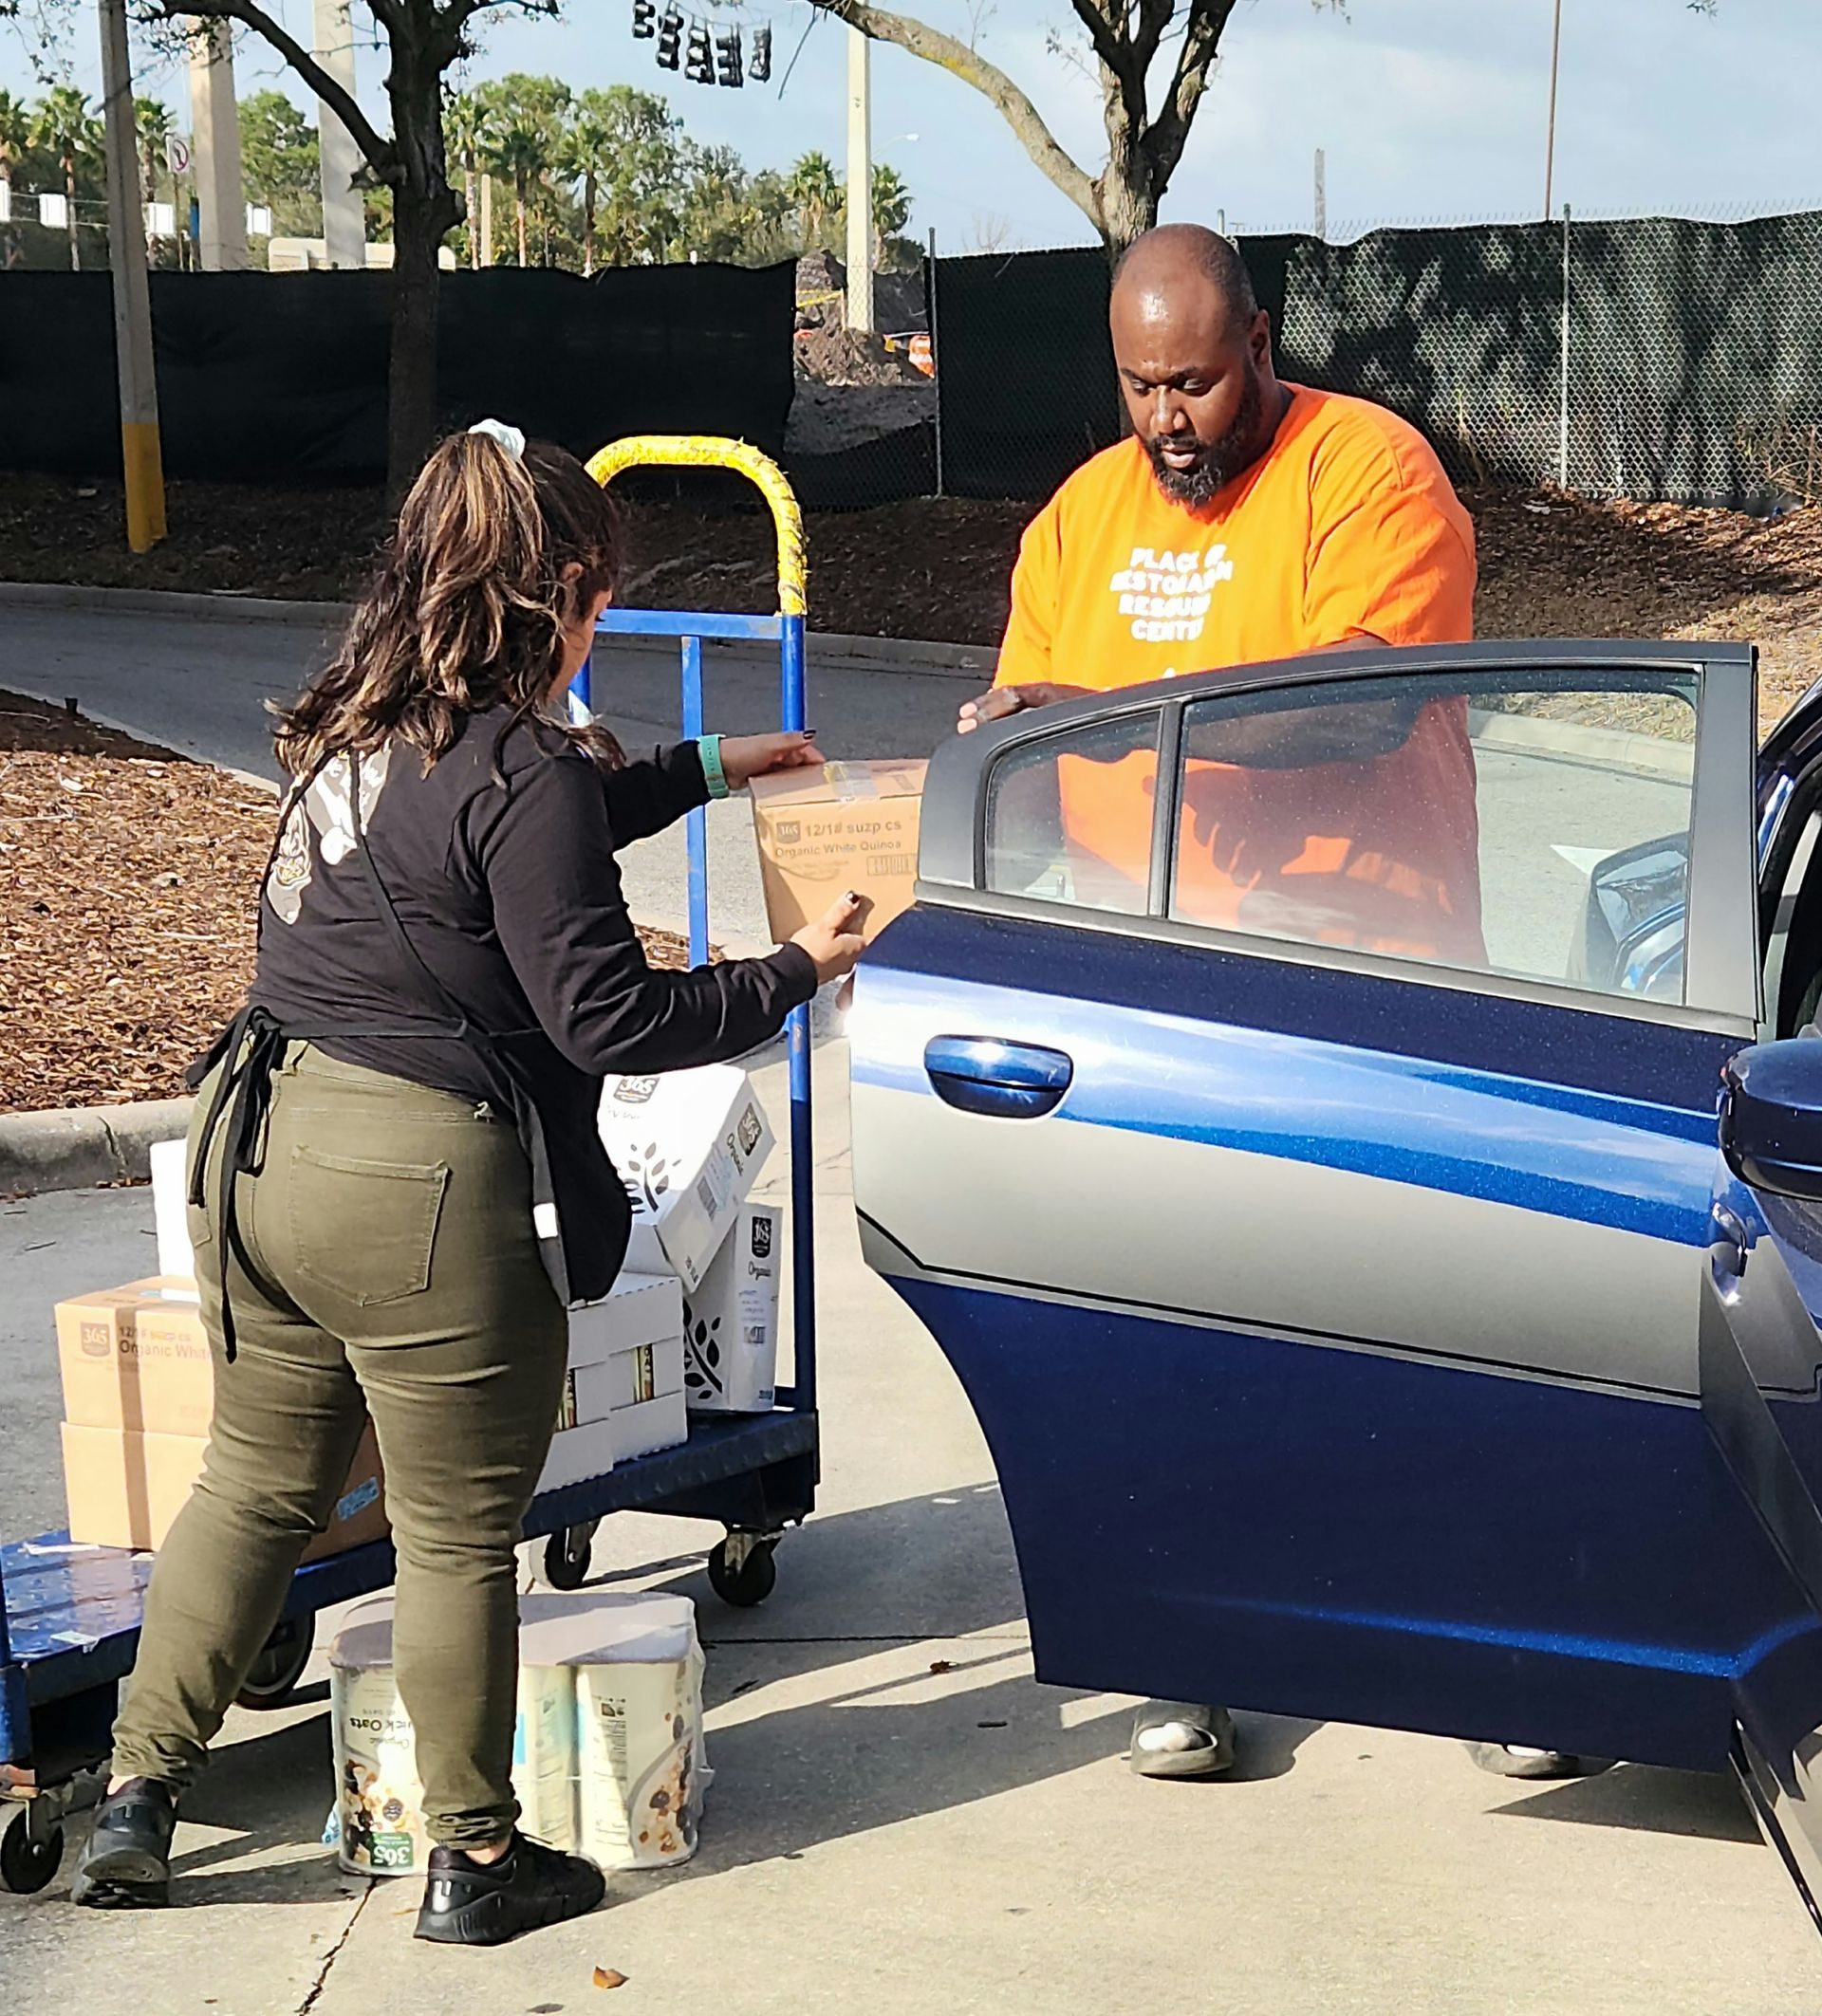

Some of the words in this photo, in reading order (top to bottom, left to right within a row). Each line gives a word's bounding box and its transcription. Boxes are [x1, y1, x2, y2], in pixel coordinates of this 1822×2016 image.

[884, 820, 902, 832] cs
[775, 842, 822, 859] Organic
[823, 842, 857, 854] White
[860, 841, 902, 852] Quinoa
[84, 1327, 107, 1345] 365
[120, 1339, 172, 1359] Organic
[348, 1717, 382, 1733] Oats
[373, 1844, 411, 1867] 365
